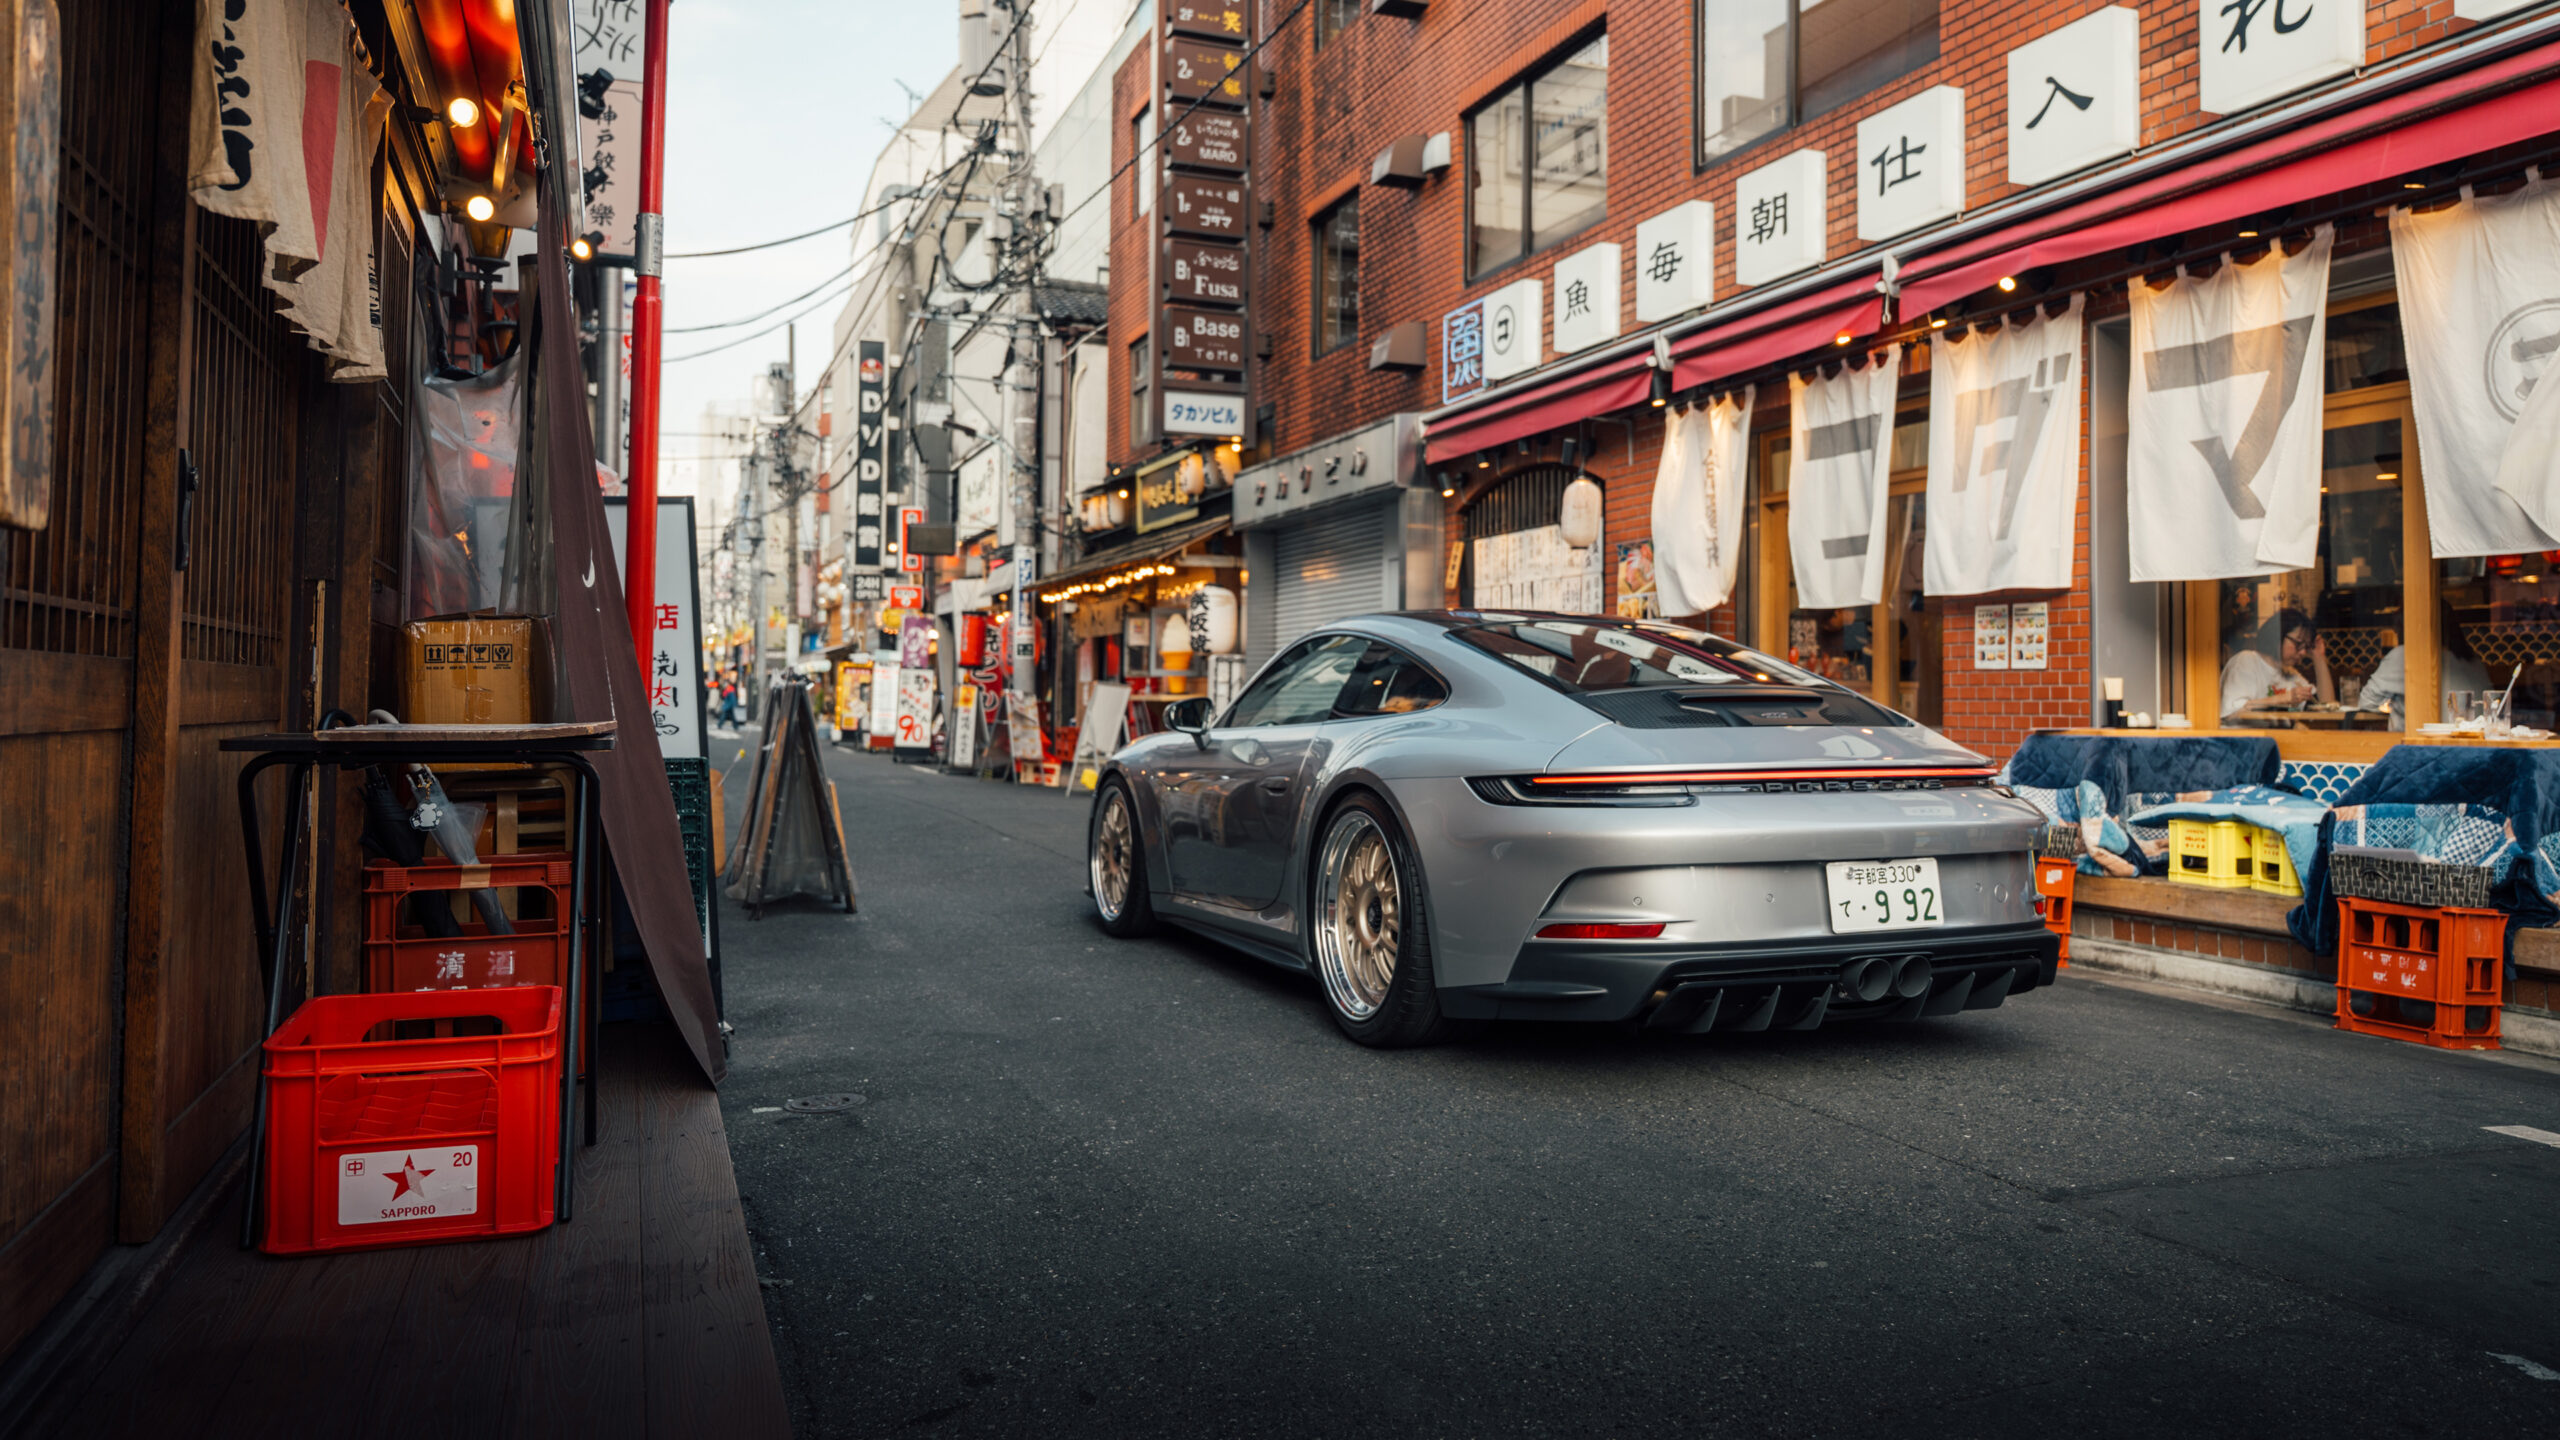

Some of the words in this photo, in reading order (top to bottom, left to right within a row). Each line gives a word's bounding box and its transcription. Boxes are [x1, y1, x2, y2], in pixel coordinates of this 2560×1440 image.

[1177, 58, 1194, 79] 2F
[2026, 76, 2095, 129] 入
[1176, 125, 1192, 147] 2F
[1871, 135, 1928, 197] 仕
[1177, 192, 1191, 213] 1F
[1747, 192, 1788, 244] 朝
[1647, 241, 1683, 283] 毎
[1194, 275, 1239, 298] Fusa
[1564, 278, 1590, 323] 魚
[1174, 326, 1190, 347] B1
[1193, 316, 1240, 338] Base
[1451, 312, 1481, 388] 魚
[2143, 314, 2315, 520] マ
[856, 576, 880, 589] 24H
[654, 604, 678, 630] 店
[1766, 779, 1944, 793] PORSCHE
[347, 1160, 363, 1175] 中
[453, 1151, 473, 1167] 20
[381, 1204, 436, 1219] SAPPORO
